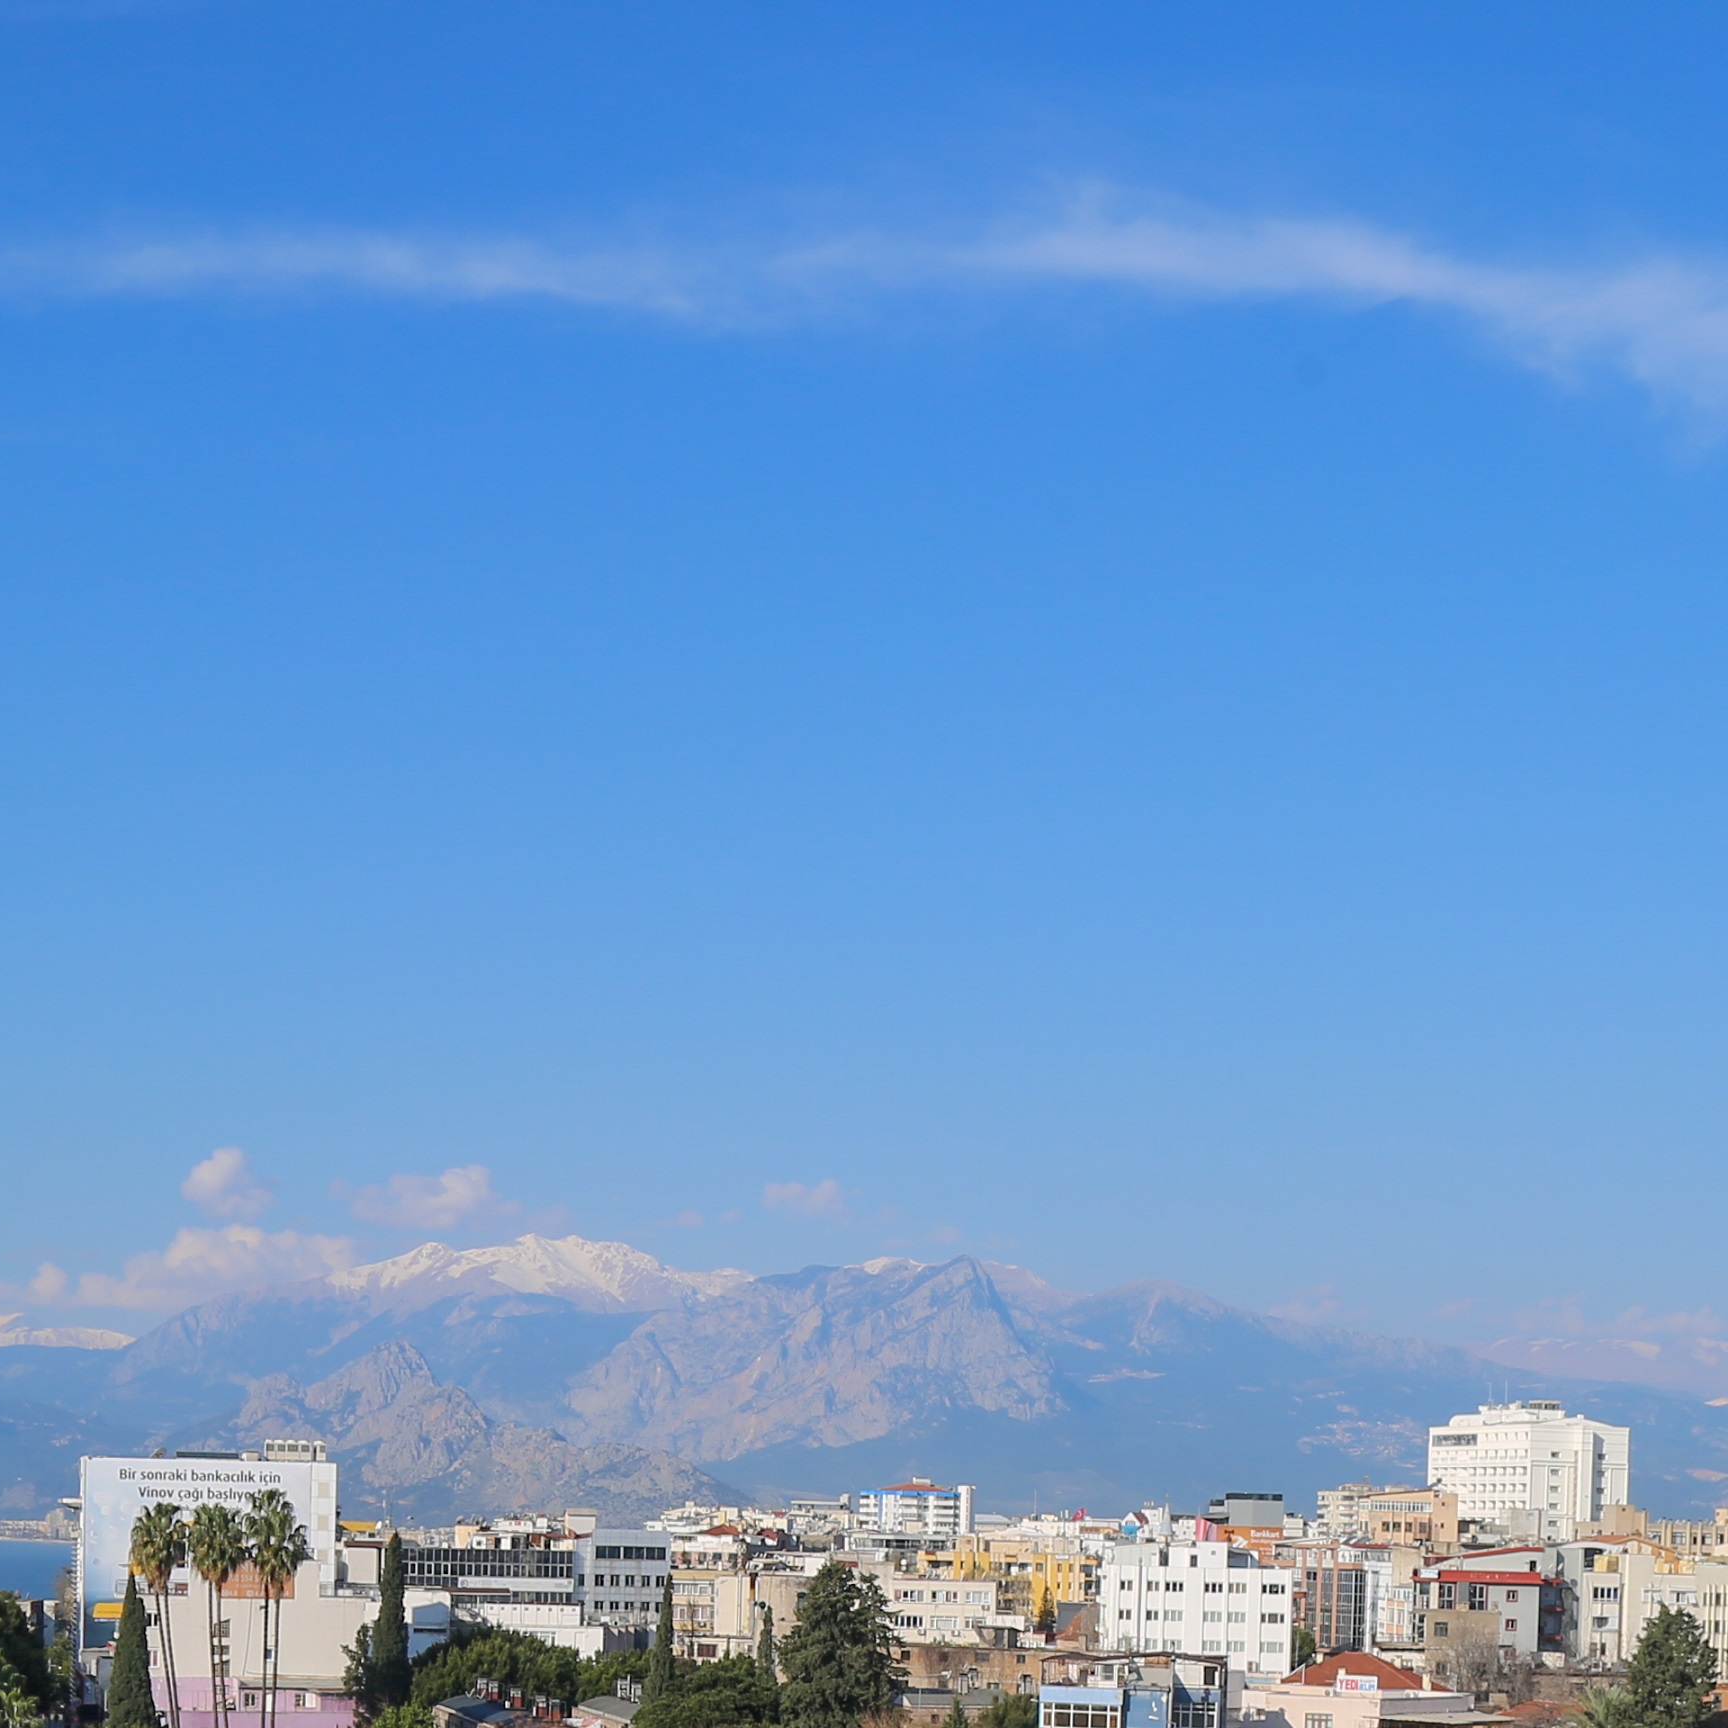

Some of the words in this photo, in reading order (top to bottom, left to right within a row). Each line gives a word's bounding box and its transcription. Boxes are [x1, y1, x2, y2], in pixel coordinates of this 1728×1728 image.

[119, 1468, 137, 1480] Bir
[140, 1469, 187, 1481] sonraki
[191, 1470, 255, 1484] bankacılık
[259, 1472, 281, 1486] için
[138, 1486, 173, 1498] Vinov
[178, 1487, 203, 1502] çağı
